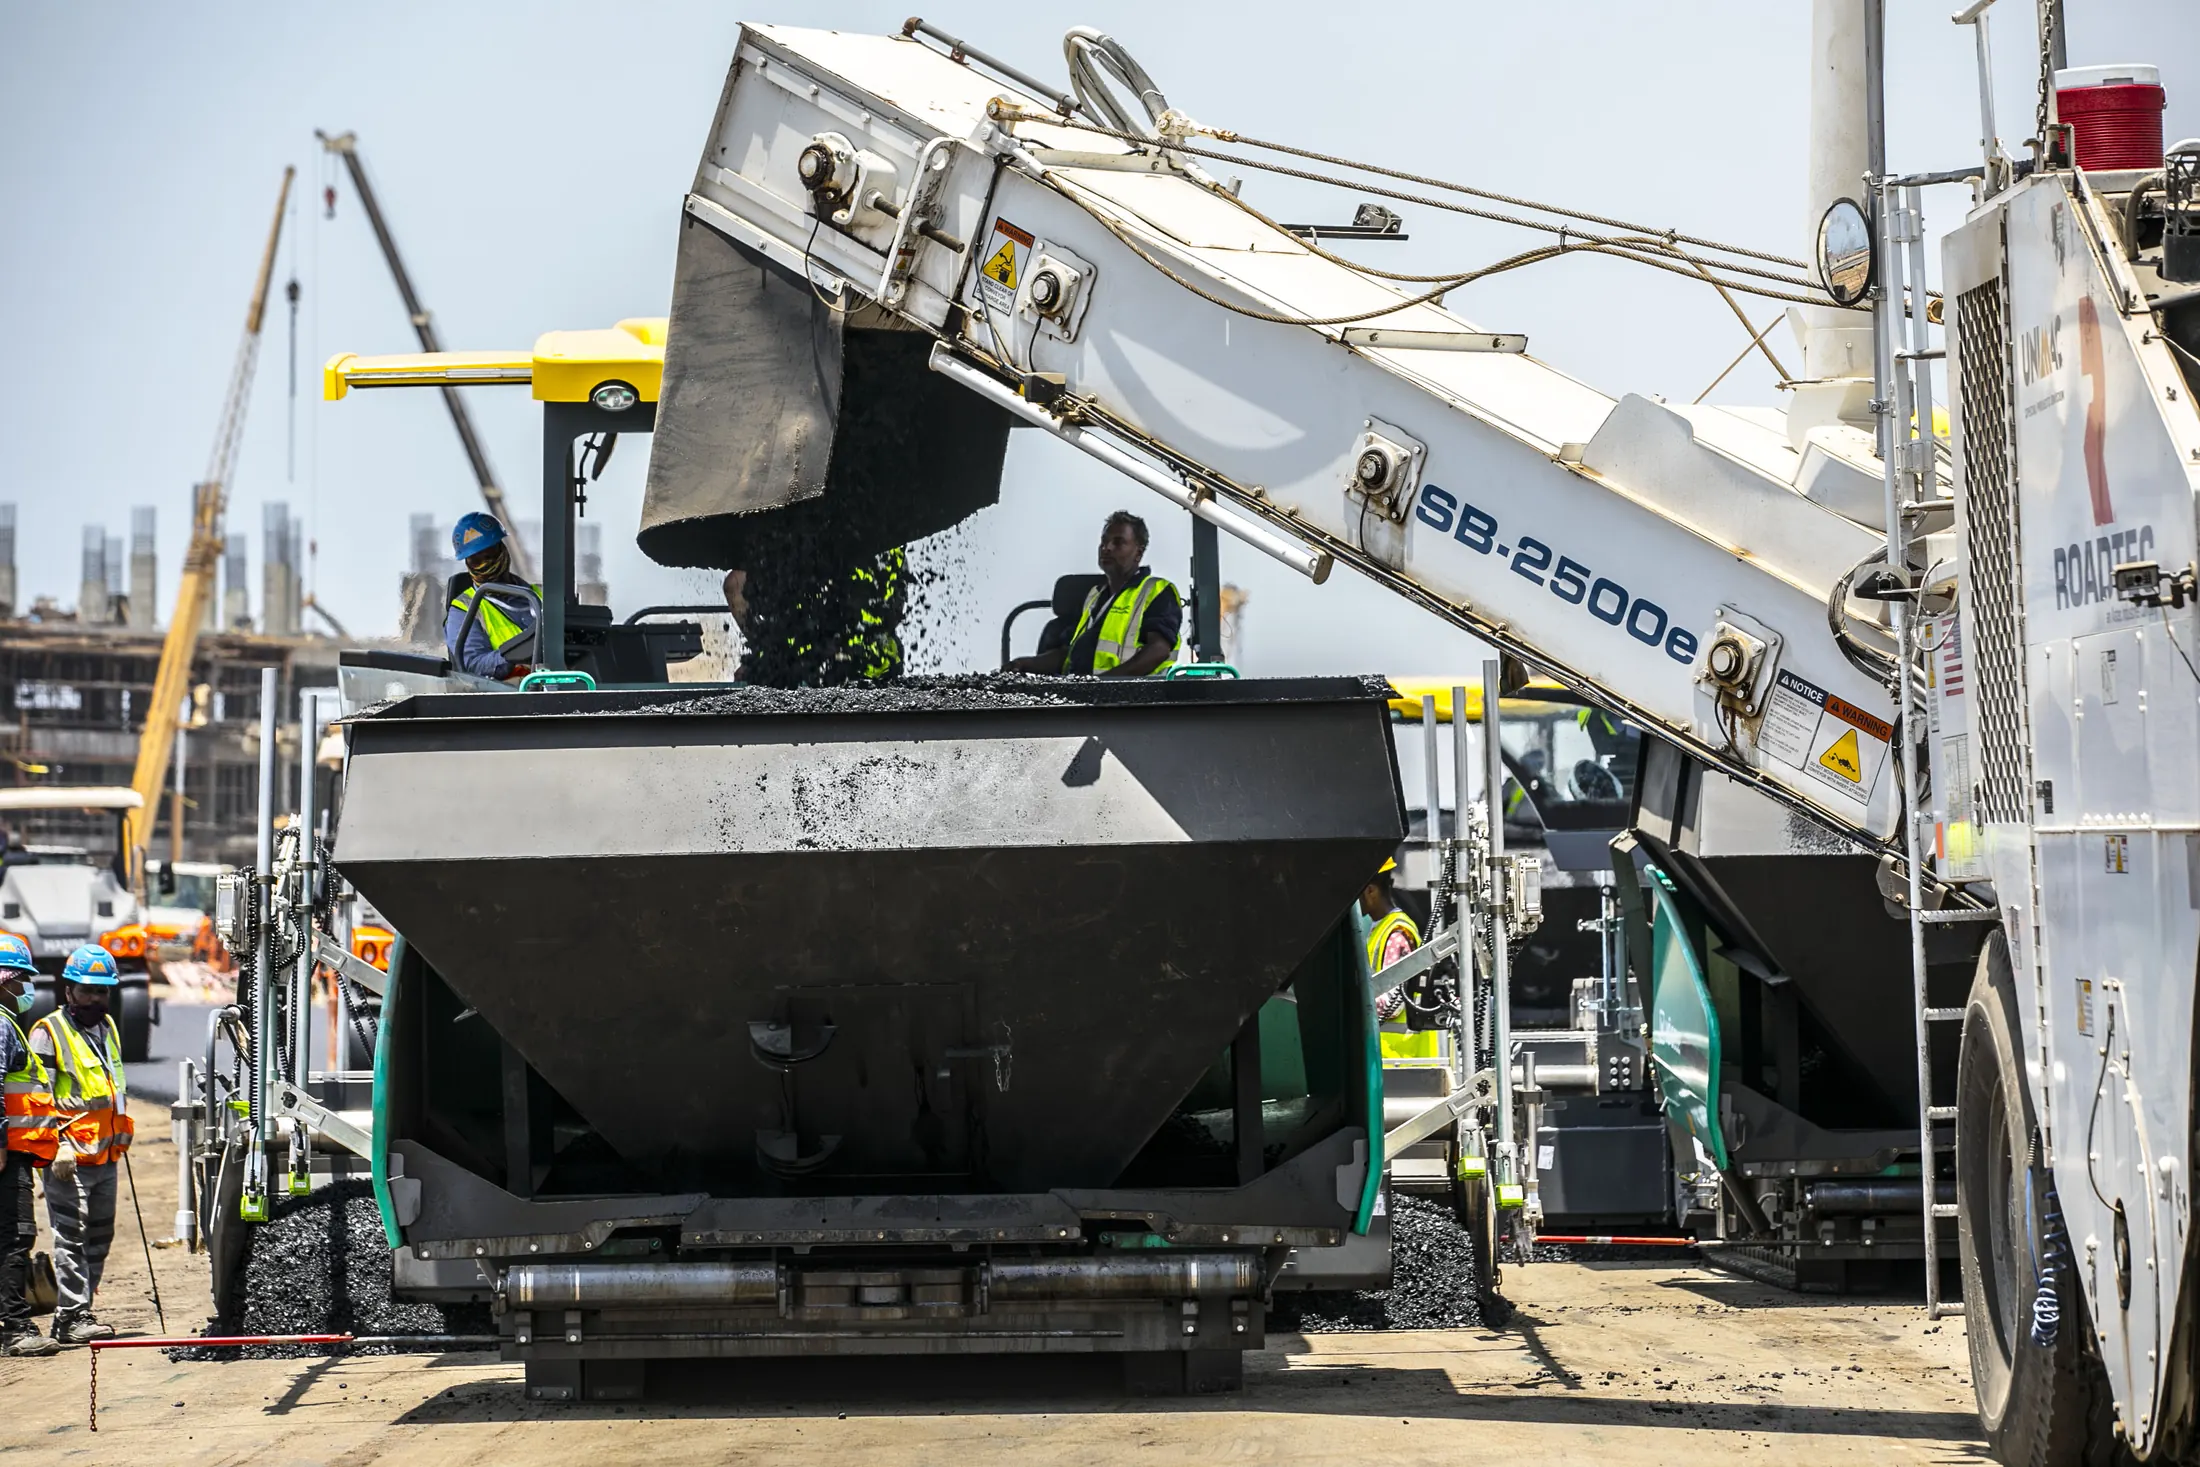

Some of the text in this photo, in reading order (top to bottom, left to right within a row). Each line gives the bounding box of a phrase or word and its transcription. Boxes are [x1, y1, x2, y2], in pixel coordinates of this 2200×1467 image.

[1003, 225, 1031, 245] WARNING
[981, 276, 994, 286] STAND
[993, 283, 1007, 294] CLEAR
[1416, 484, 1698, 665] SB-2500e
[1790, 678, 1824, 703] NOTICE
[1842, 704, 1888, 737] WARNING
[1823, 767, 1833, 776] MOVE
[1833, 773, 1849, 785] MACHINE
